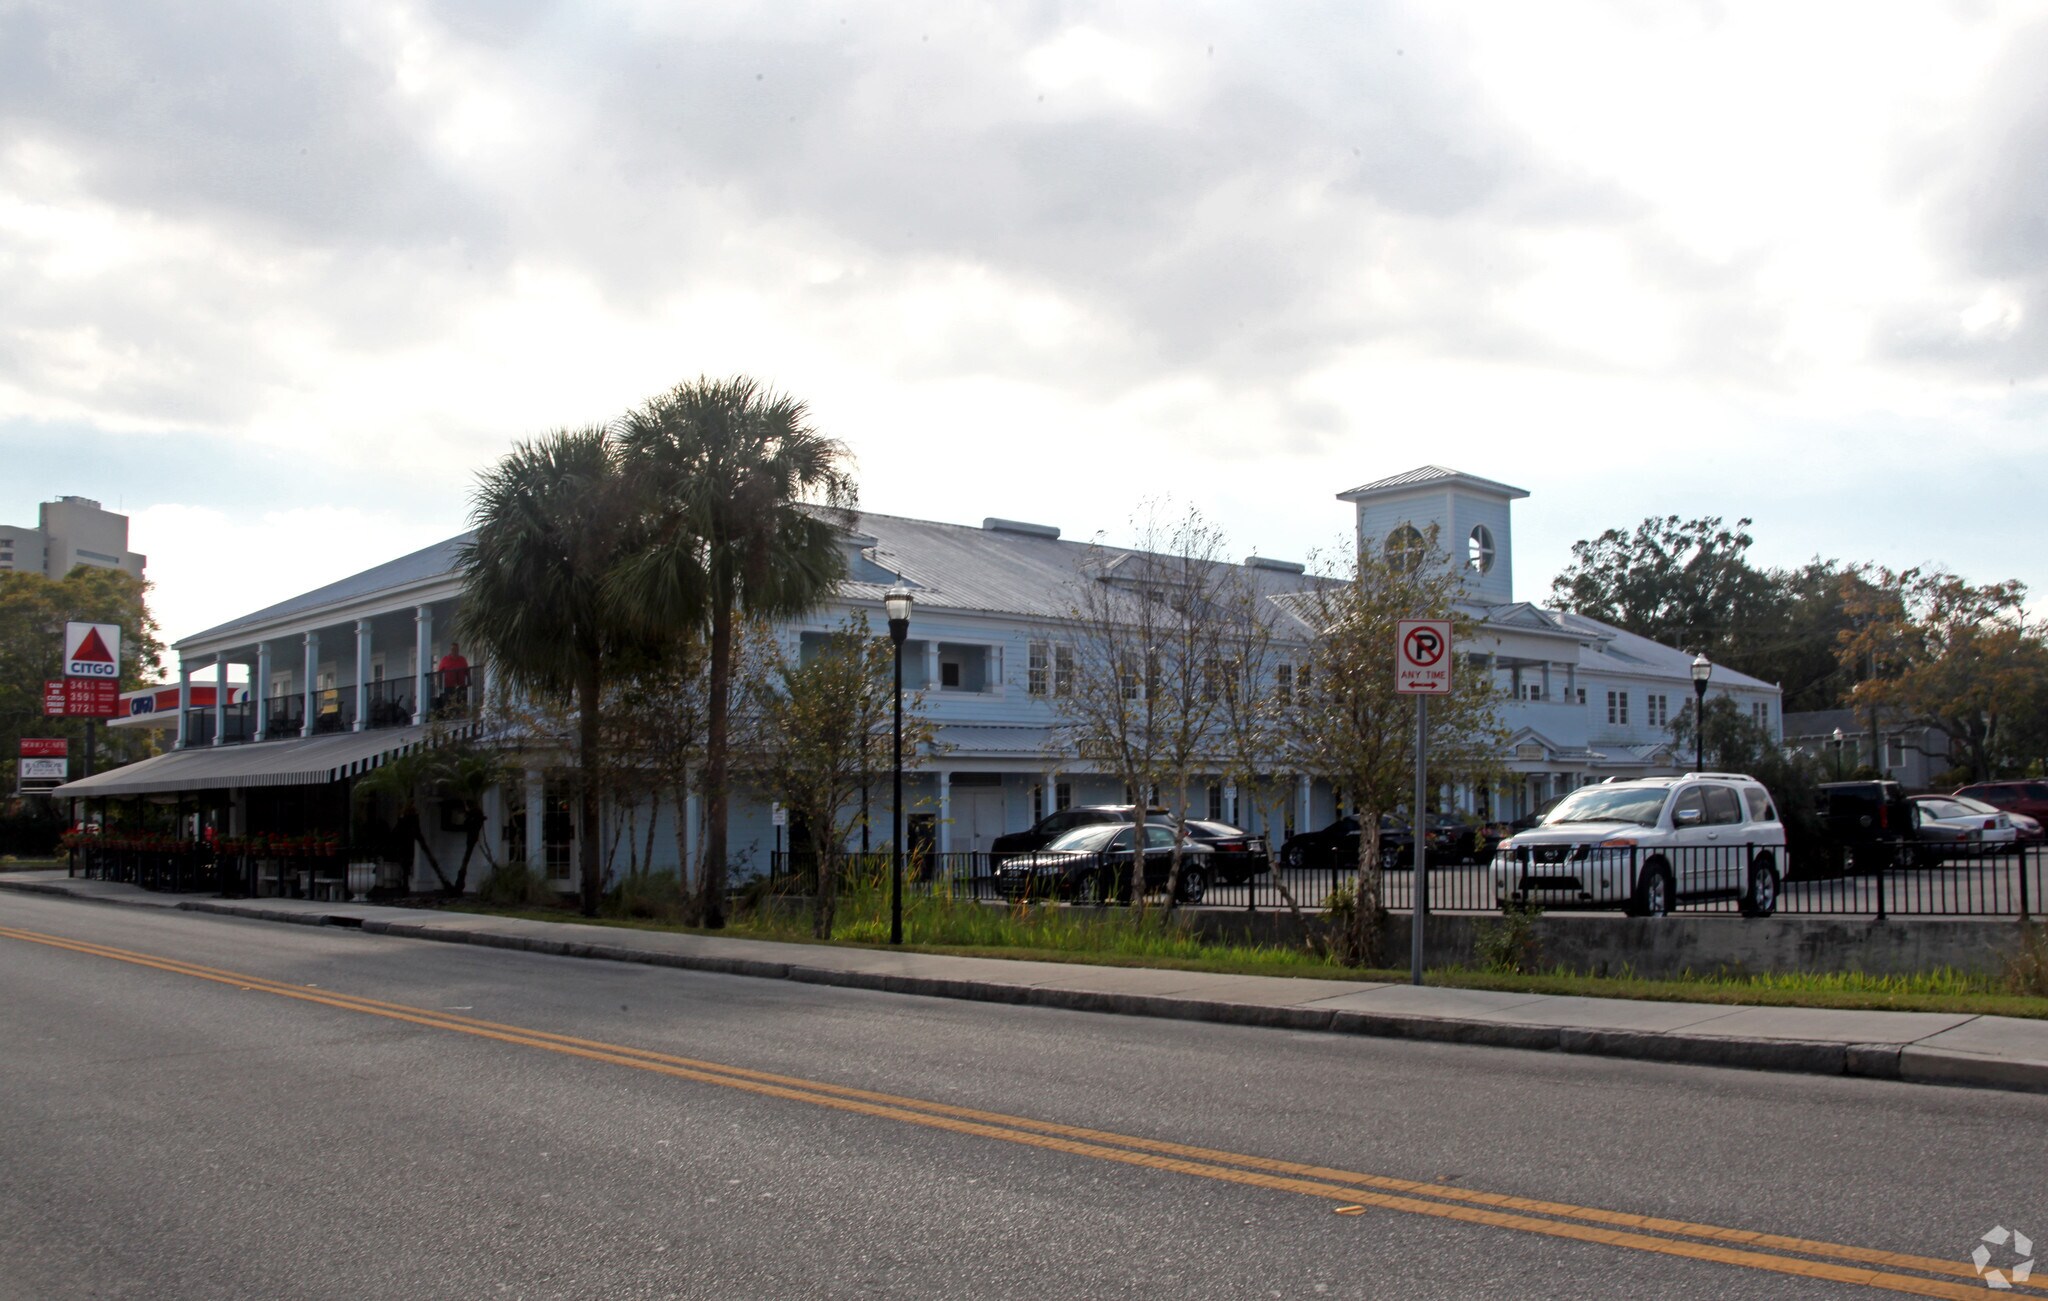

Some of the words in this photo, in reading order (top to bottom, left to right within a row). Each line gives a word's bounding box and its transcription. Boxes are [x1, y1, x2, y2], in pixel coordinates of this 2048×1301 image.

[1416, 634, 1438, 660] P
[71, 662, 115, 675] CITGO
[1401, 670, 1421, 679] ANY
[1426, 670, 1446, 680] TIME
[70, 692, 90, 702] 359
[70, 703, 90, 713] 372
